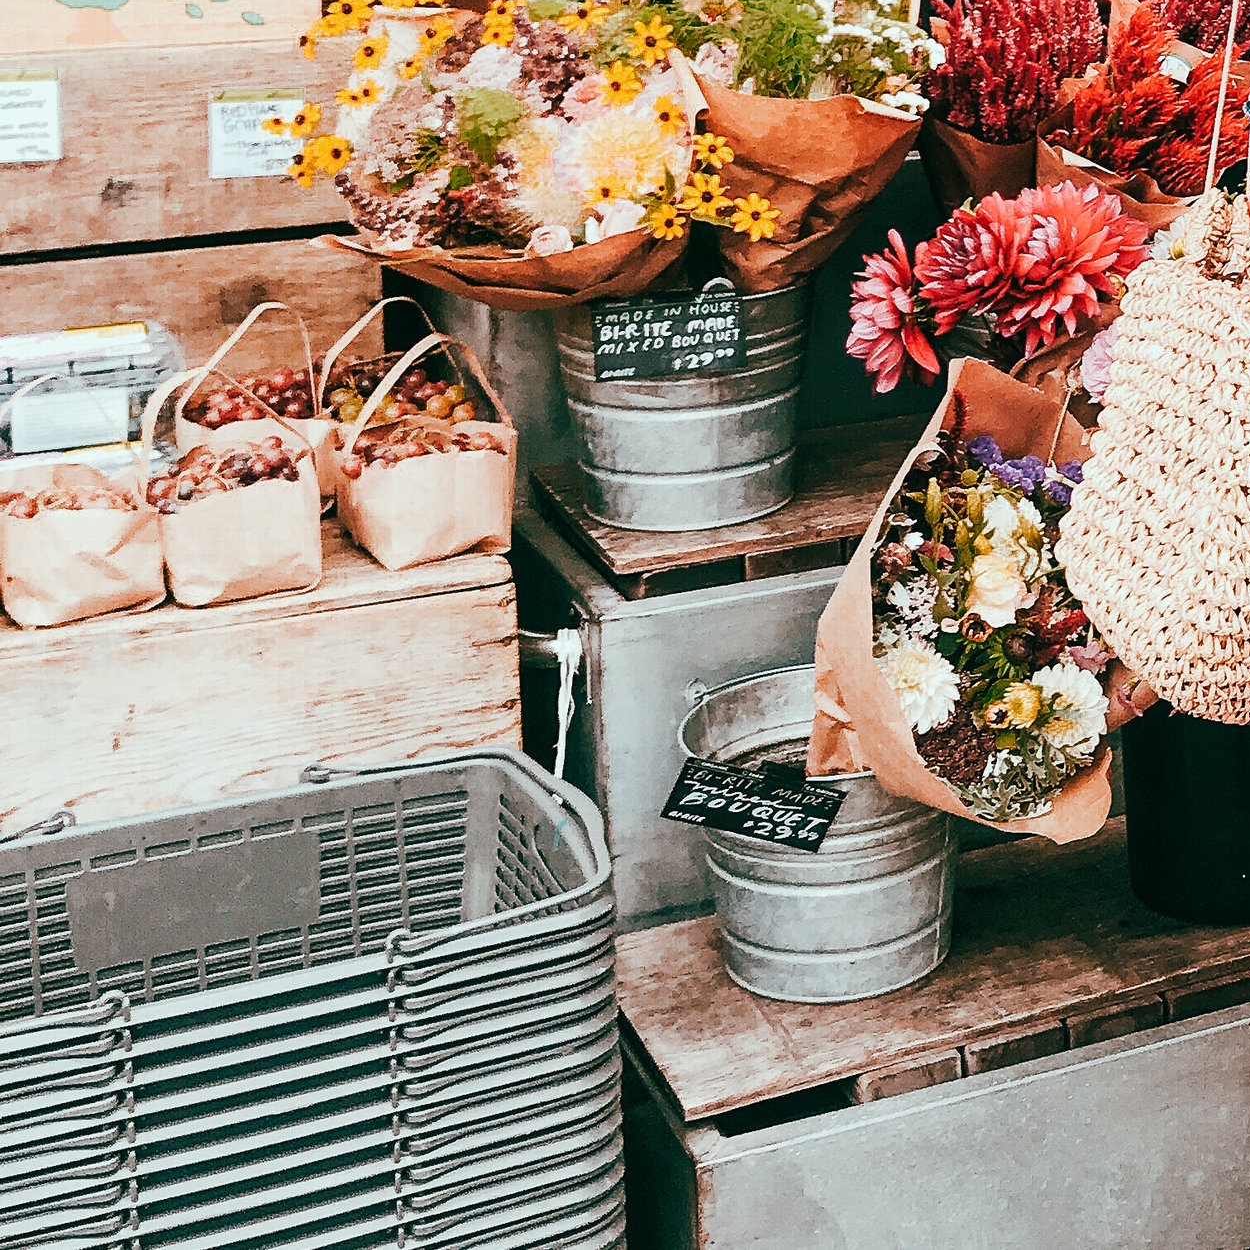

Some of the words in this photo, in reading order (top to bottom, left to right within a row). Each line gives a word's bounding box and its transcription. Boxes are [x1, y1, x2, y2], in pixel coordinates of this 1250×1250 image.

[605, 310, 654, 323] MADE
[663, 307, 682, 316] IN
[689, 301, 732, 315] HOUSE
[687, 315, 736, 333] MADE
[597, 337, 665, 355] MIXED
[671, 328, 741, 348] BOUQUET
[771, 789, 823, 806] MADE
[679, 791, 829, 831] BOUQUET
